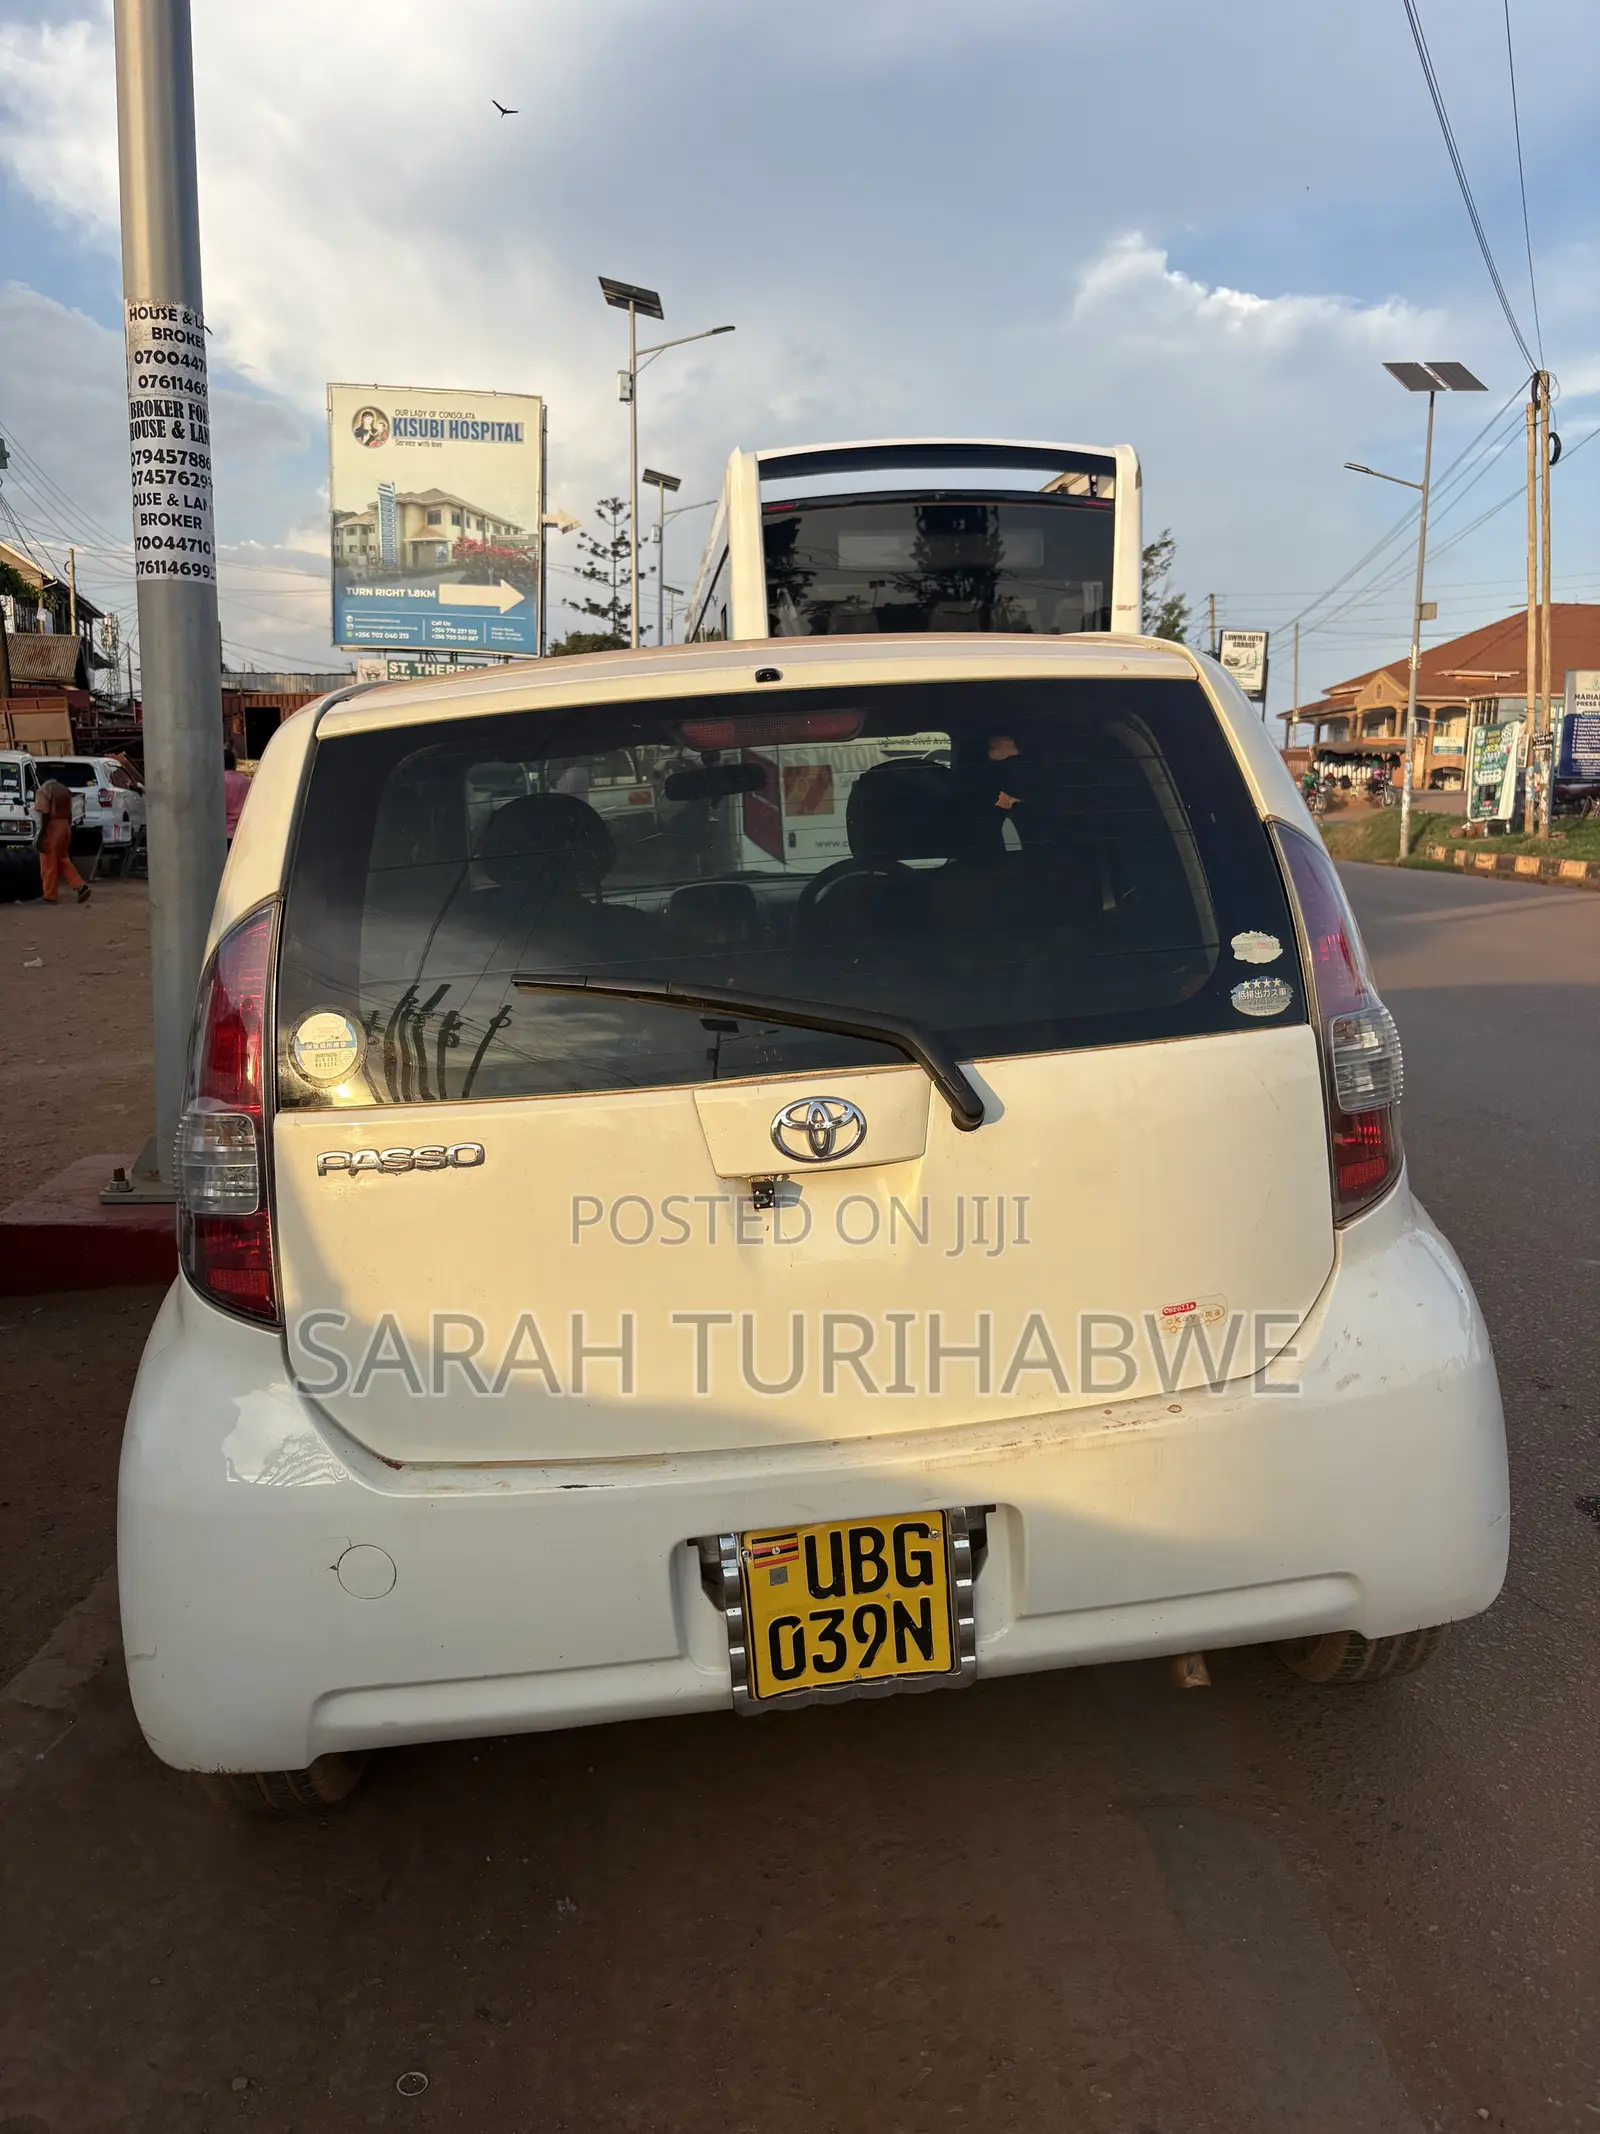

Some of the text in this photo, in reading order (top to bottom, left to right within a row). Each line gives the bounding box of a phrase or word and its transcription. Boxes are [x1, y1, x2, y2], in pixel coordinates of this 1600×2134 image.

[129, 306, 178, 321] HOUSE
[182, 311, 192, 325] &
[130, 399, 184, 420] BROKER
[395, 408, 476, 420] OUR LADY OF CONSOLATA
[171, 420, 186, 439] &
[392, 417, 523, 442] KISUBI HOSPITAL
[395, 439, 416, 447] Service
[166, 493, 179, 507] &
[140, 513, 203, 530] BROKER
[135, 535, 211, 555] 70044710
[345, 587, 436, 598] TURN RIGHT 1.8KM
[389, 662, 484, 675] ST. THERE
[912, 736, 931, 745] Civil
[815, 840, 852, 848] www.c
[316, 1142, 486, 1177] PASSO
[1163, 1302, 1195, 1314] Corolla
[804, 1522, 934, 1600] UBG
[768, 1596, 935, 1681] 039N
